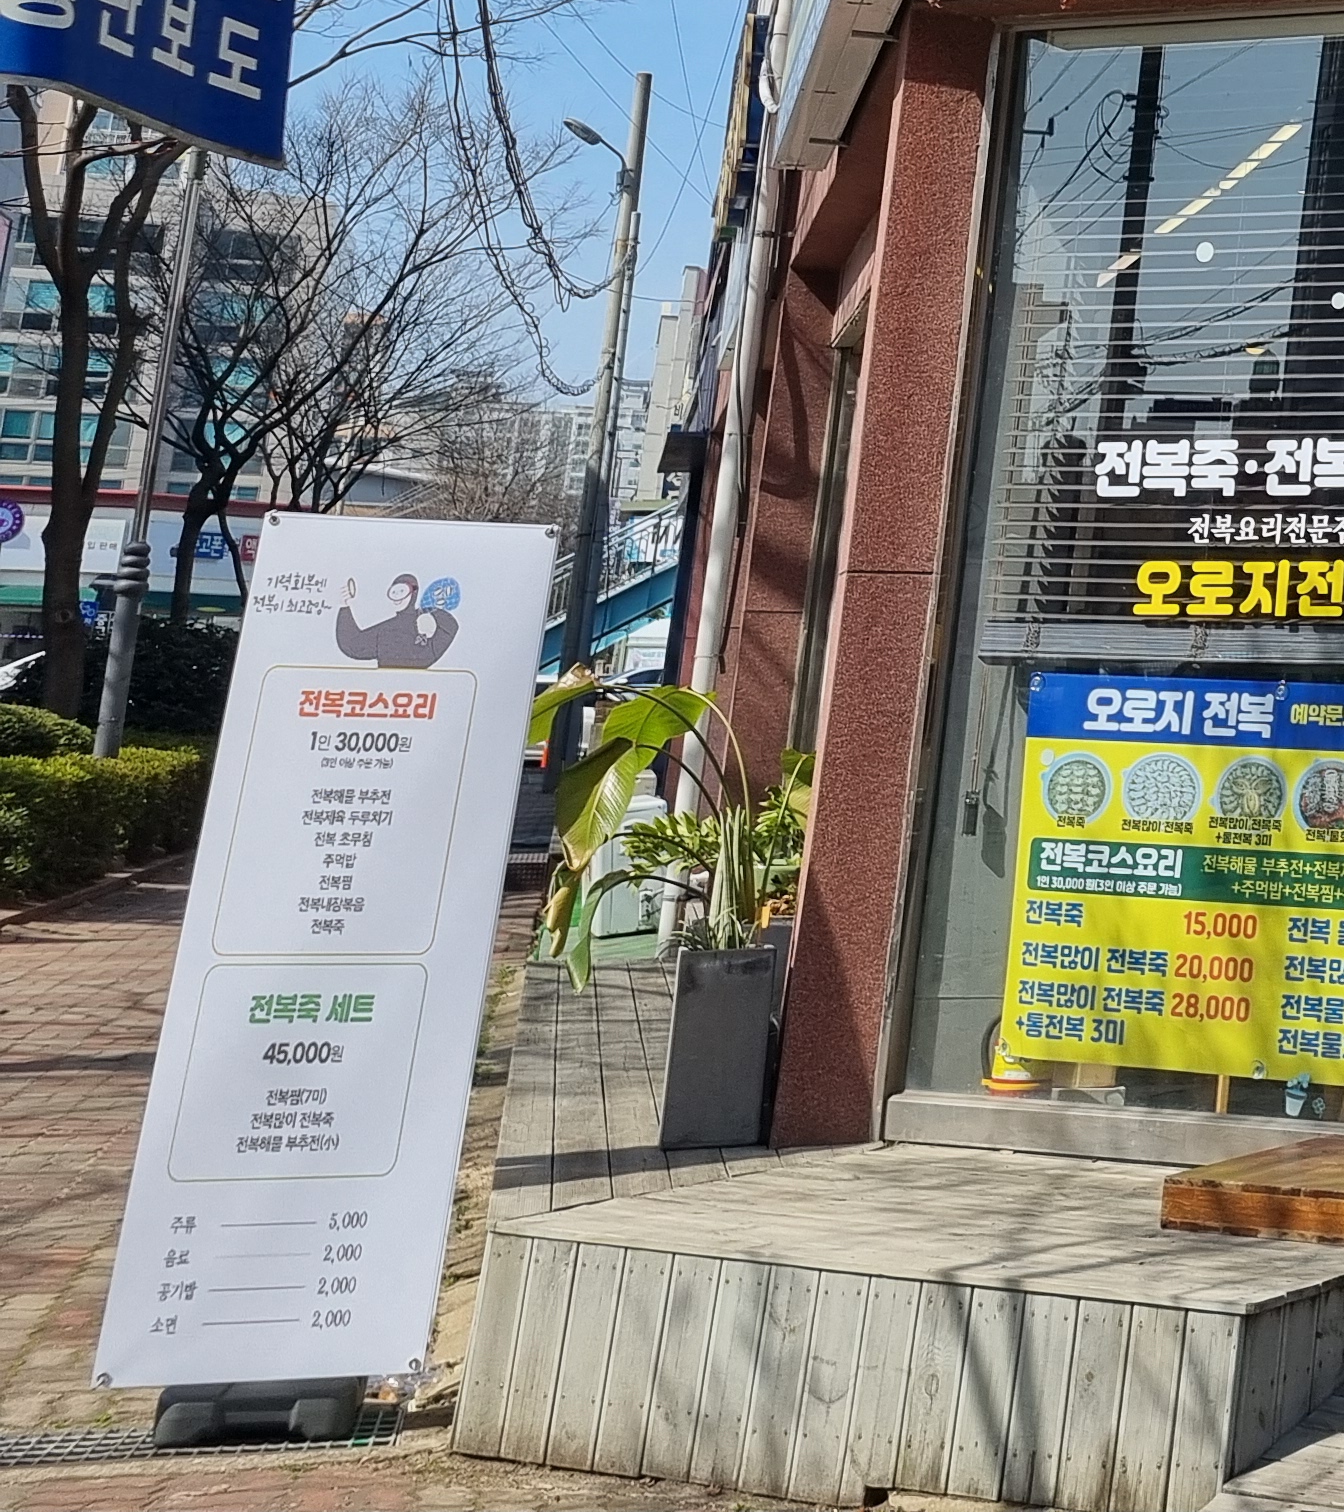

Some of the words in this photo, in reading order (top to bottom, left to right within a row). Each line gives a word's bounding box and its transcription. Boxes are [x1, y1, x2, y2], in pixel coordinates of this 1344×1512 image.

[267, 572, 327, 593] 기력회복엔
[298, 690, 437, 720] 전복코스요리
[1083, 688, 1195, 735] 오로지
[1202, 692, 1275, 738] 전복
[311, 731, 331, 751] 1인
[334, 732, 412, 754] 30,000원
[311, 789, 356, 804] 전복해물
[301, 810, 346, 826] 전복제육
[348, 810, 393, 826] 두루치기
[338, 831, 373, 847] 초무침
[322, 853, 357, 868] 주먹밥
[1039, 842, 1183, 879] 전복코스요리
[1202, 854, 1257, 875] 전복해물
[318, 875, 353, 890] 전복찜
[298, 897, 365, 912] 전복내장볶음
[310, 919, 345, 935] 전복죽
[1025, 899, 1083, 927] 전복죽
[1184, 911, 1258, 939] 15,000
[1287, 917, 1330, 944] 전복
[1021, 942, 1099, 972] 전복많이
[1106, 947, 1168, 977] 전복죽
[1174, 954, 1254, 983] 20,000
[249, 994, 322, 1023] 전복죽
[325, 994, 376, 1023] 세트
[1018, 980, 1096, 1011] 전복많이
[1102, 986, 1165, 1016] 전복죽
[1170, 993, 1251, 1022] 28,000
[1015, 1012, 1084, 1042] +통전복
[1091, 1018, 1126, 1045] 3미
[262, 1042, 344, 1066] 45,000원
[266, 1088, 327, 1106] 전복찜(7미)
[250, 1111, 297, 1130] 전복많이
[298, 1110, 334, 1128] 전복죽
[236, 1136, 282, 1153] 전복해물
[328, 1211, 368, 1231] 5,000
[322, 1243, 362, 1264] 2,000
[317, 1276, 357, 1296] 2,000
[311, 1309, 351, 1329] 2,000
